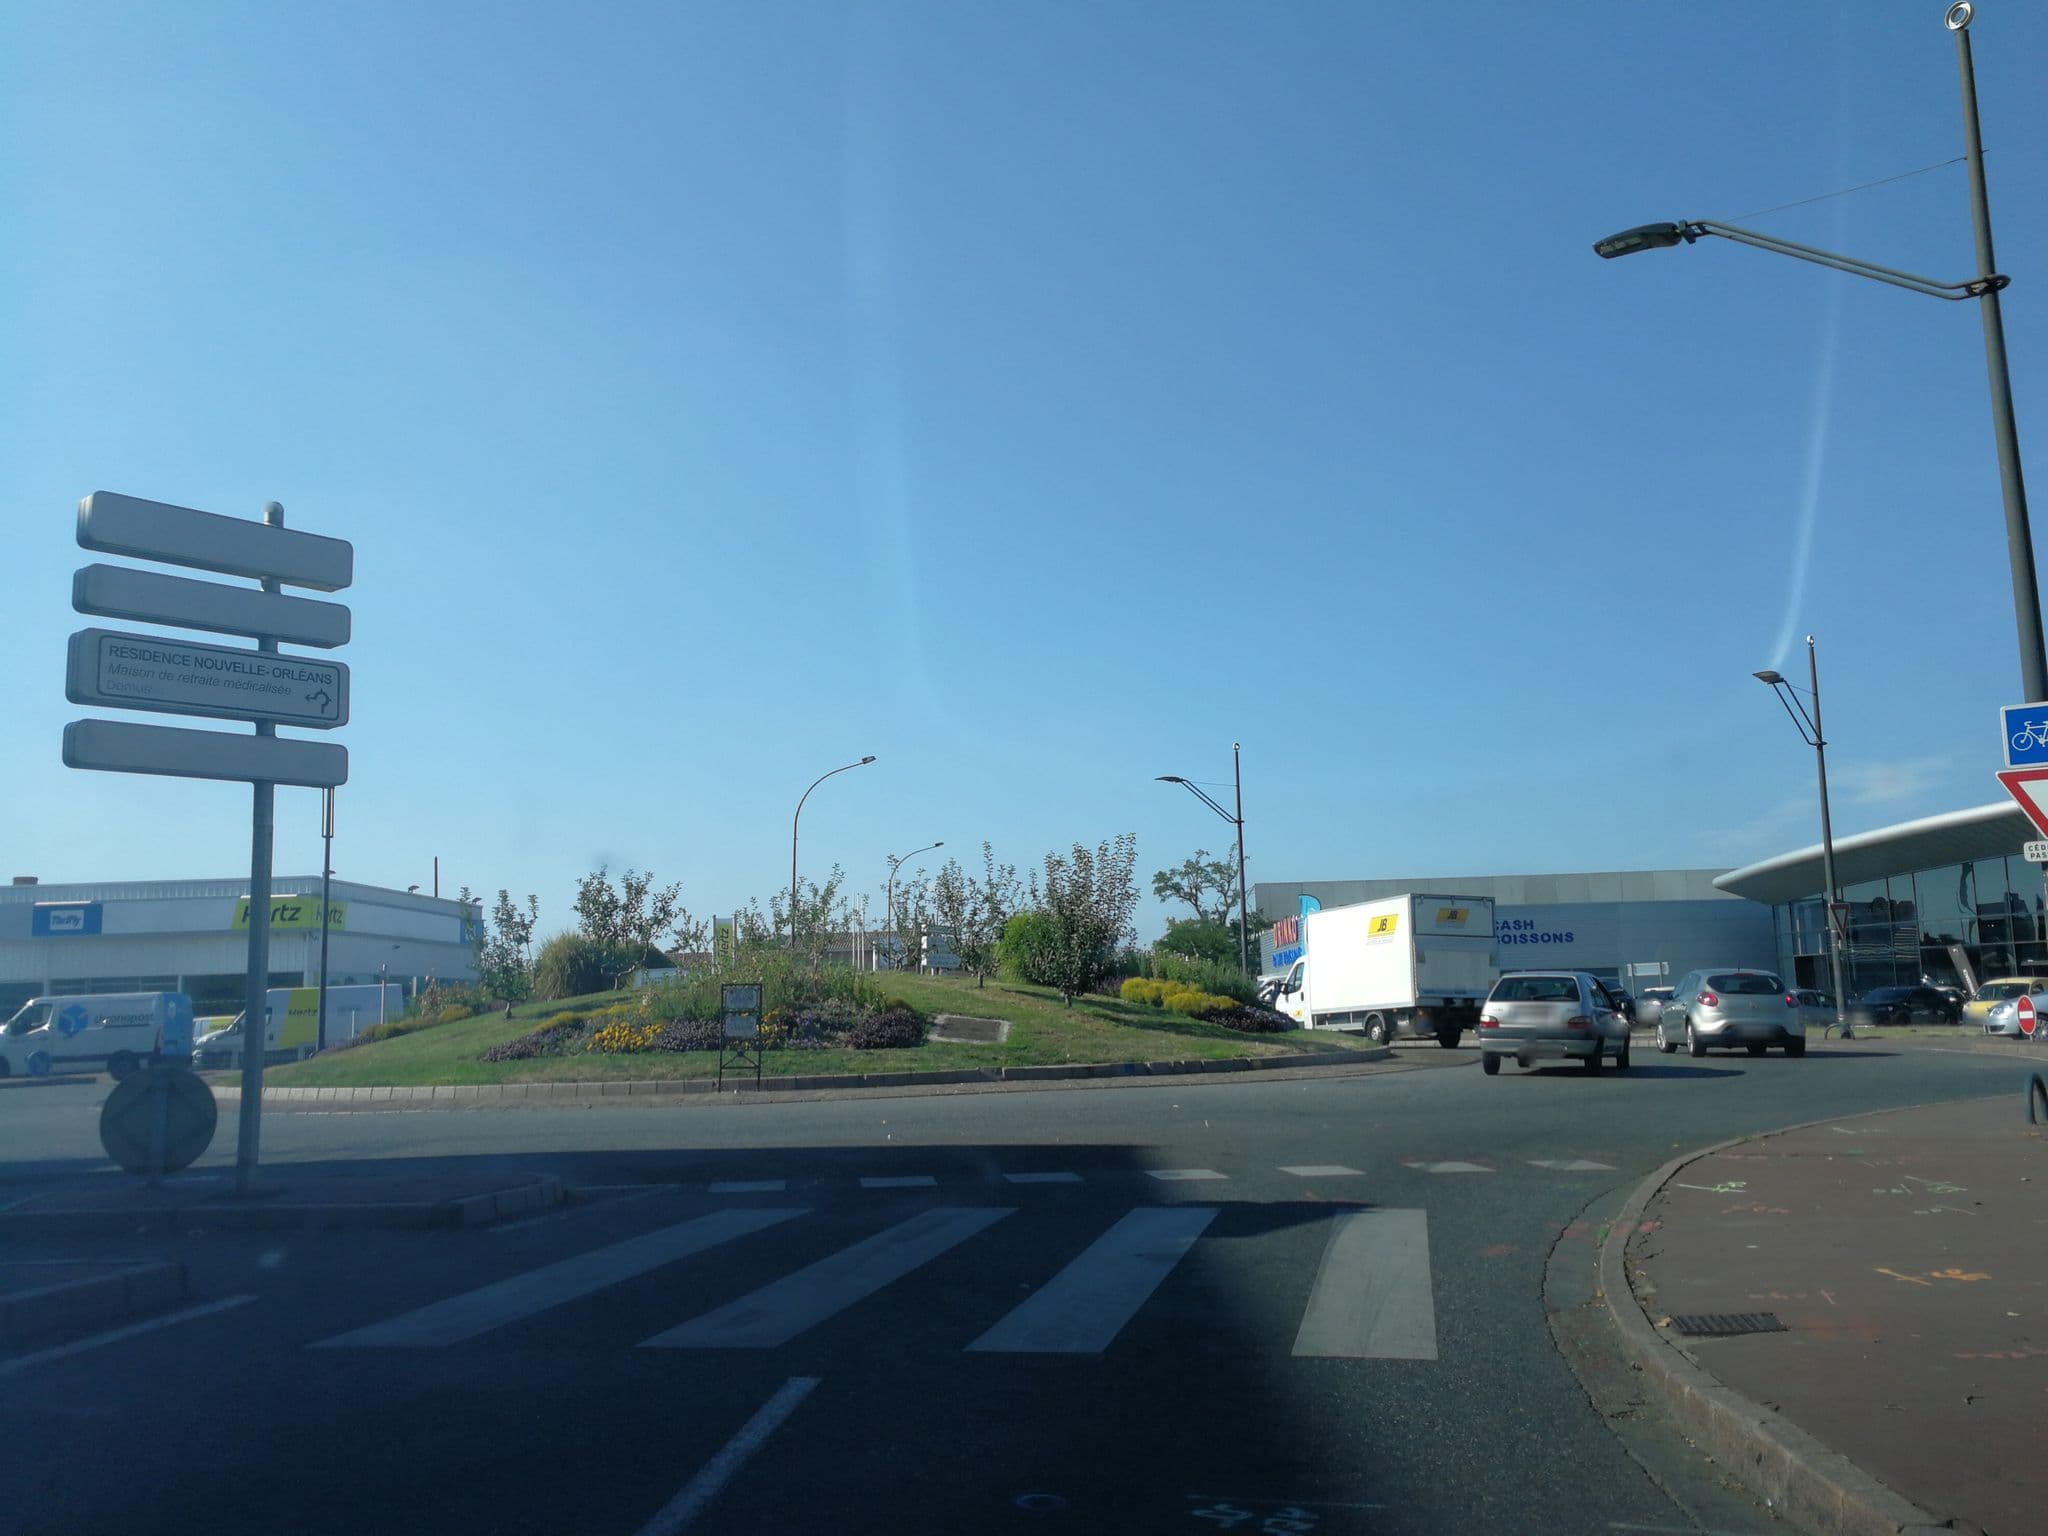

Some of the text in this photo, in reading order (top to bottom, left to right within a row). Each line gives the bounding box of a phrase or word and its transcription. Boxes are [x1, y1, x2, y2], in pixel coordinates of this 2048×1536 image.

[109, 643, 191, 667] RÉSIDENCE
[108, 663, 155, 679] Maison
[158, 670, 174, 681] de
[177, 672, 220, 687] retraite
[1497, 932, 1574, 945] OISSONS
